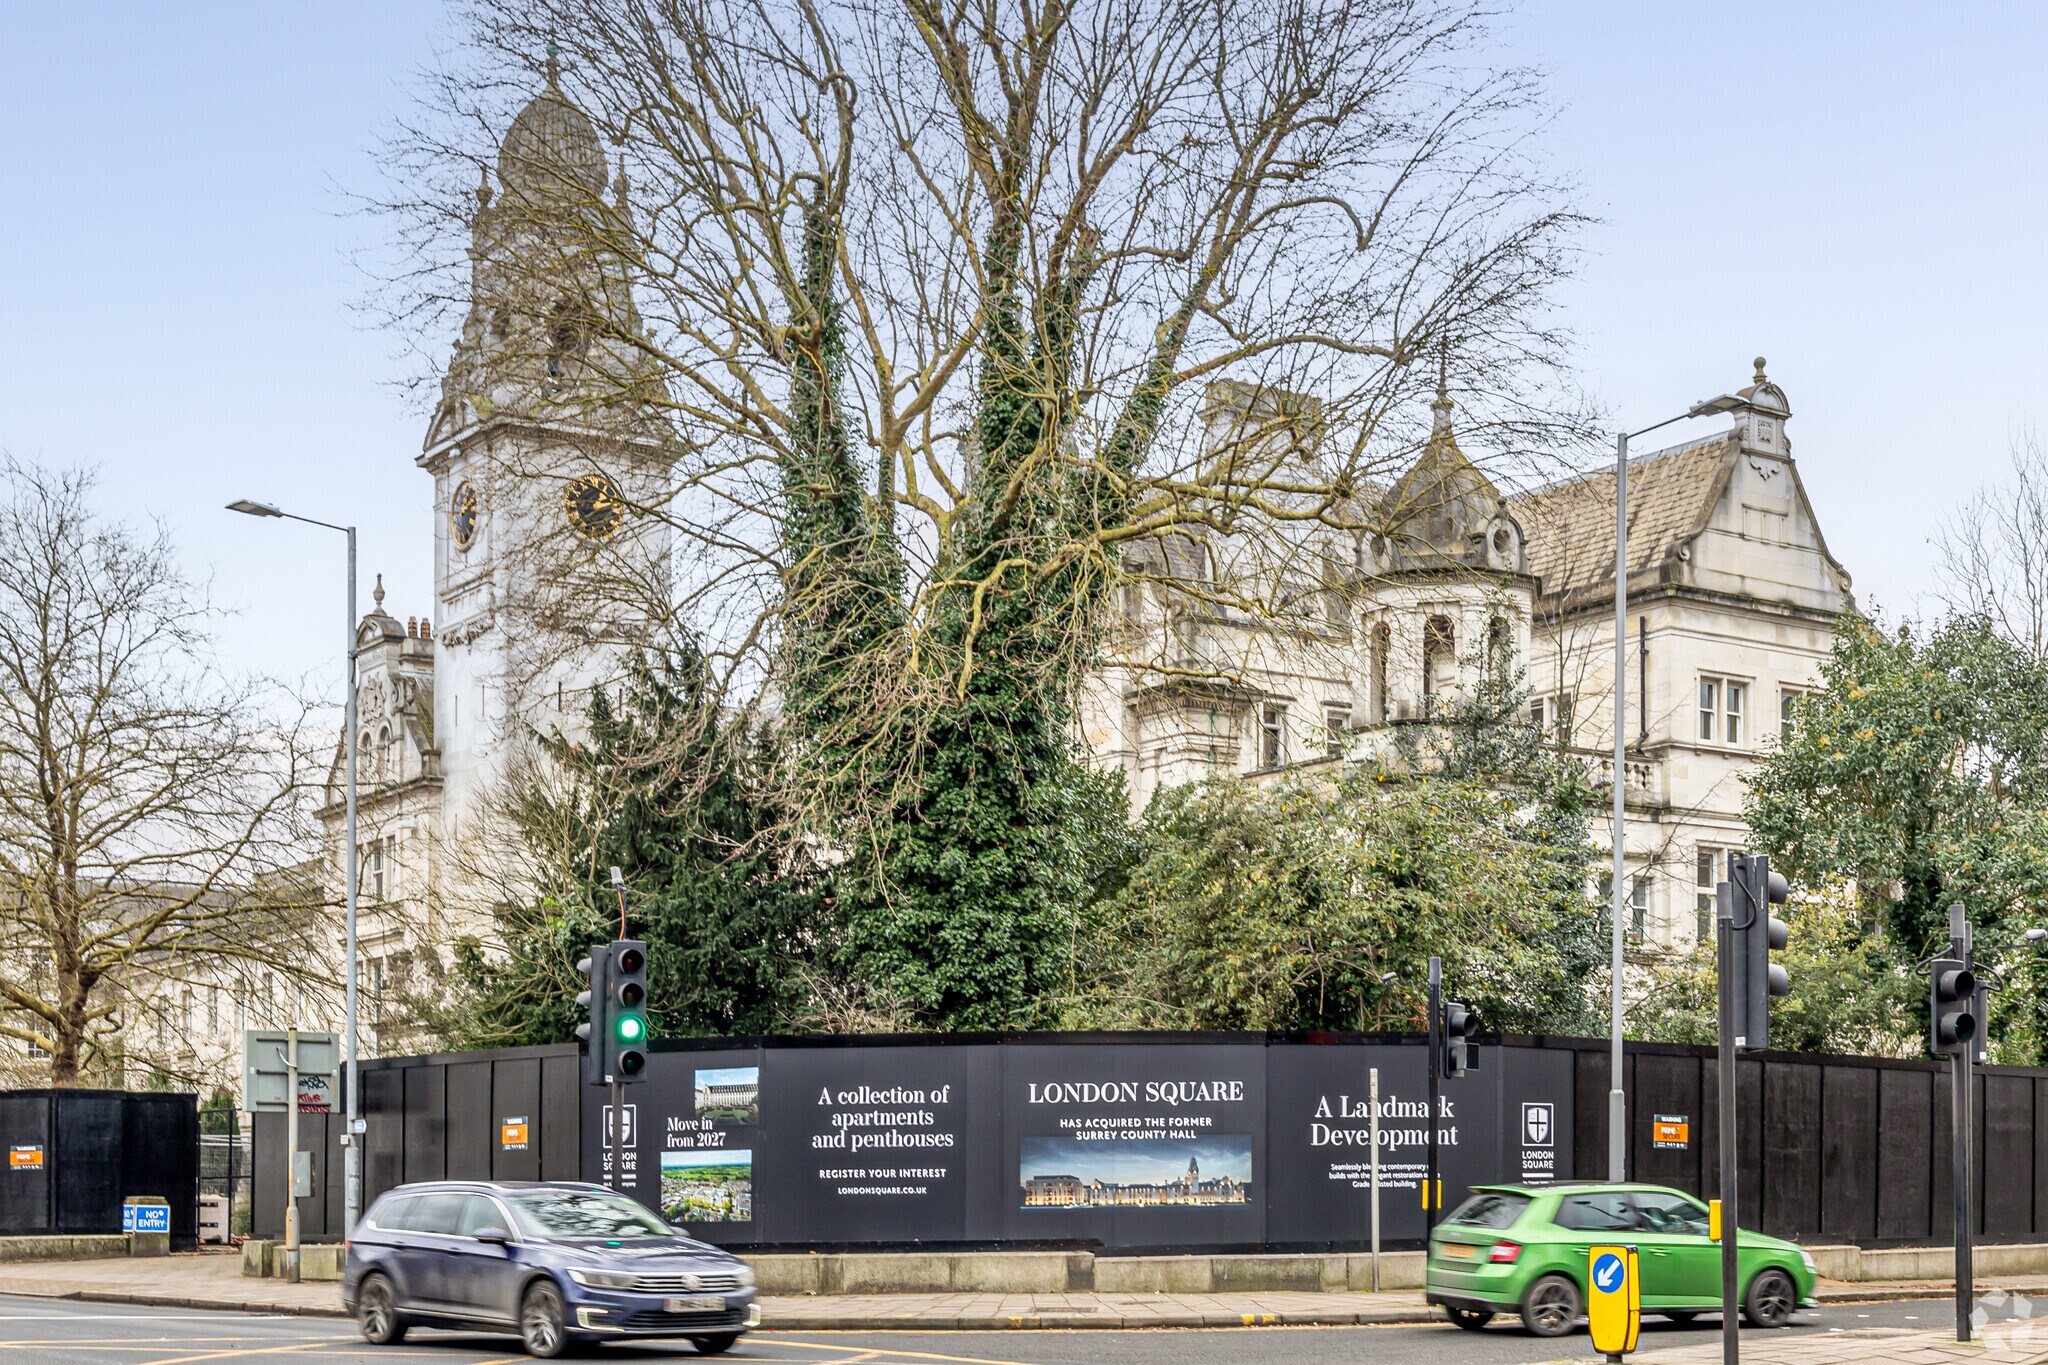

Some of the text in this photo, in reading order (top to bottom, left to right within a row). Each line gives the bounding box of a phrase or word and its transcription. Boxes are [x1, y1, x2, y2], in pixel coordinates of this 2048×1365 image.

[818, 1085, 950, 1105] A collection of
[1028, 1080, 1244, 1106] LONDON SQUARE
[1314, 1095, 1333, 1118] A
[666, 1115, 713, 1132] Move in
[831, 1109, 934, 1128] apartments
[1060, 1117, 1212, 1129] HAS ACQUIRED THE FORMER
[666, 1130, 727, 1148] from 2027
[812, 1129, 954, 1152] and penthouses
[1076, 1130, 1196, 1140] SURREY COUNTY HALL
[1522, 1151, 1554, 1160] LONDON
[1522, 1160, 1554, 1169] SQUARE
[819, 1169, 947, 1179] REGISTER YOUR INTEREST
[837, 1186, 927, 1195] LONDONSQUARE.CO.UK
[145, 1210, 159, 1218] NO
[138, 1219, 165, 1228] ENTRY
